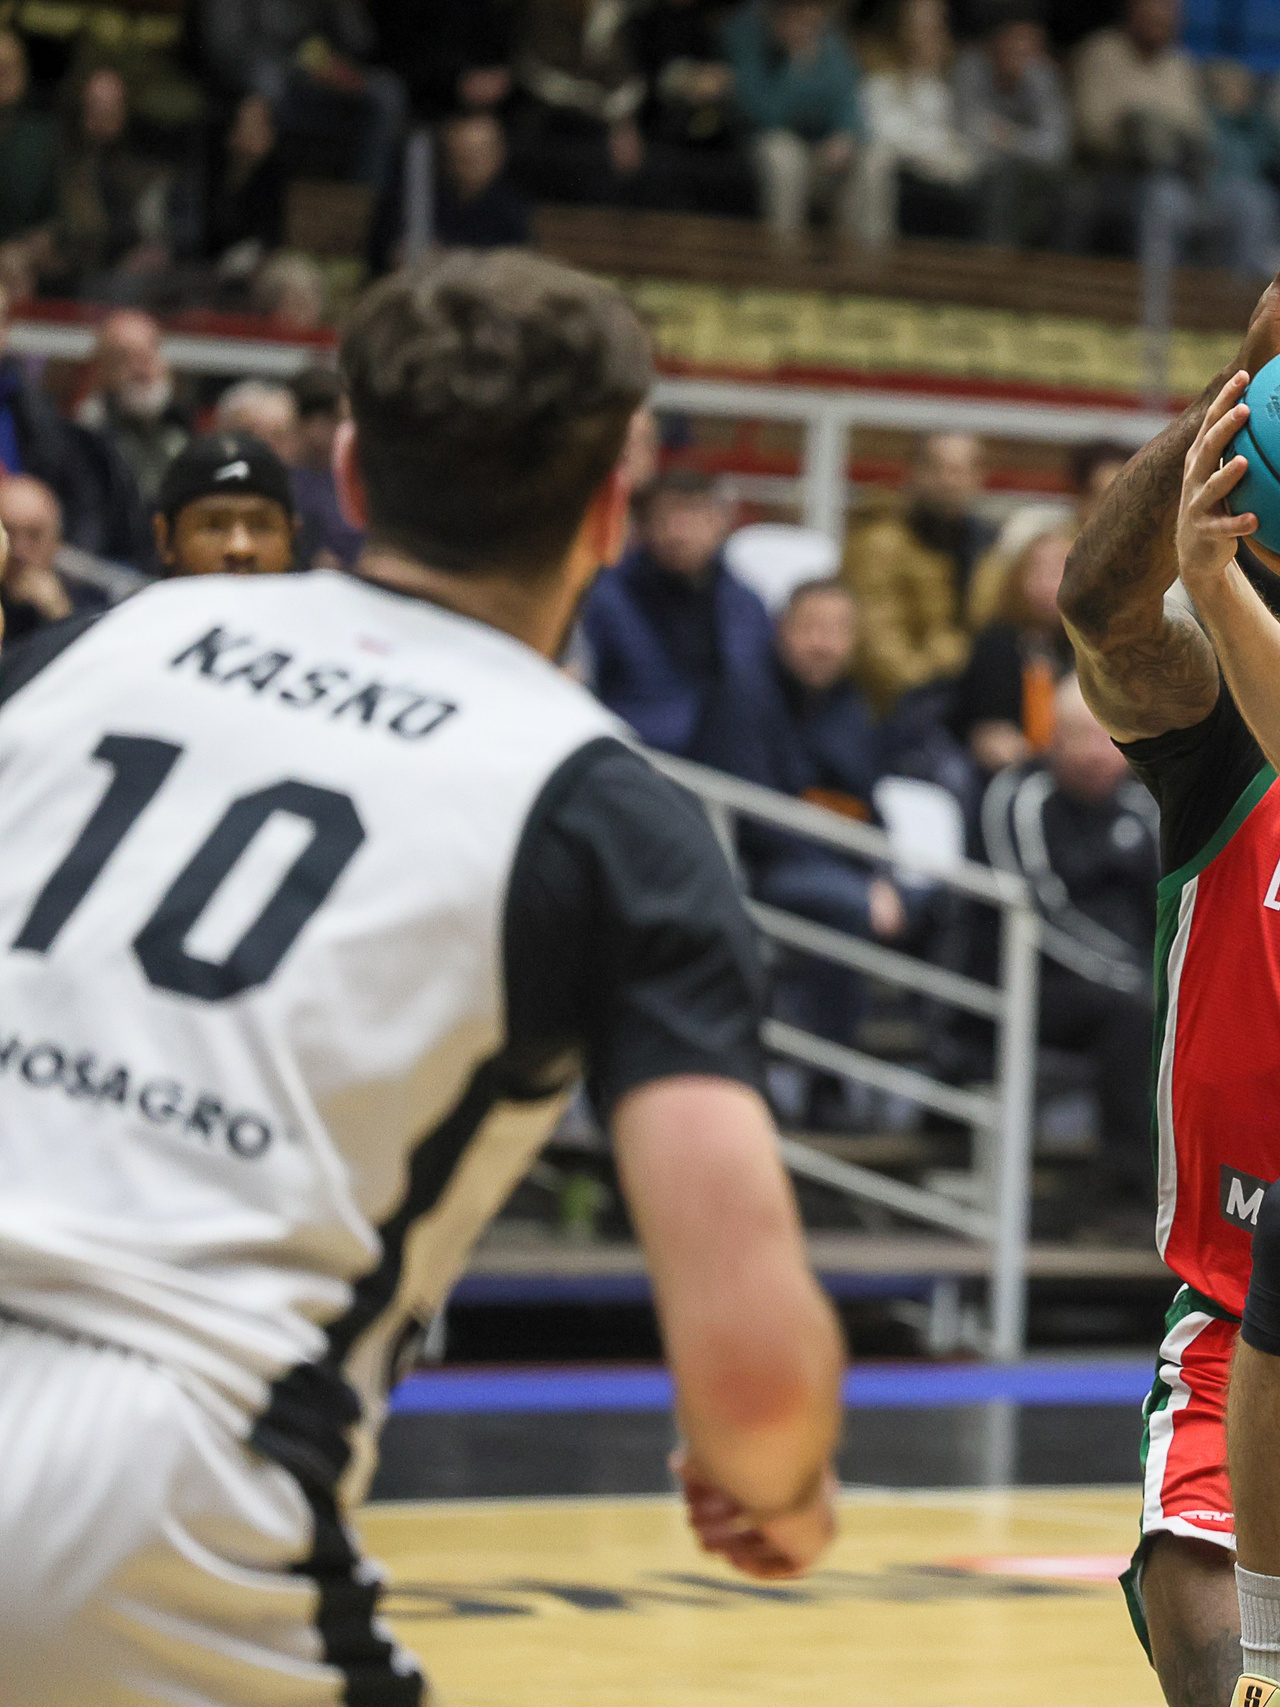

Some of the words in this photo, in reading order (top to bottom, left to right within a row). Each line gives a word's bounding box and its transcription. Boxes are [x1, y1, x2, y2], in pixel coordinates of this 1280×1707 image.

[171, 624, 458, 739] KASKO
[10, 733, 366, 1003] 10
[1226, 1177, 1265, 1226] M
